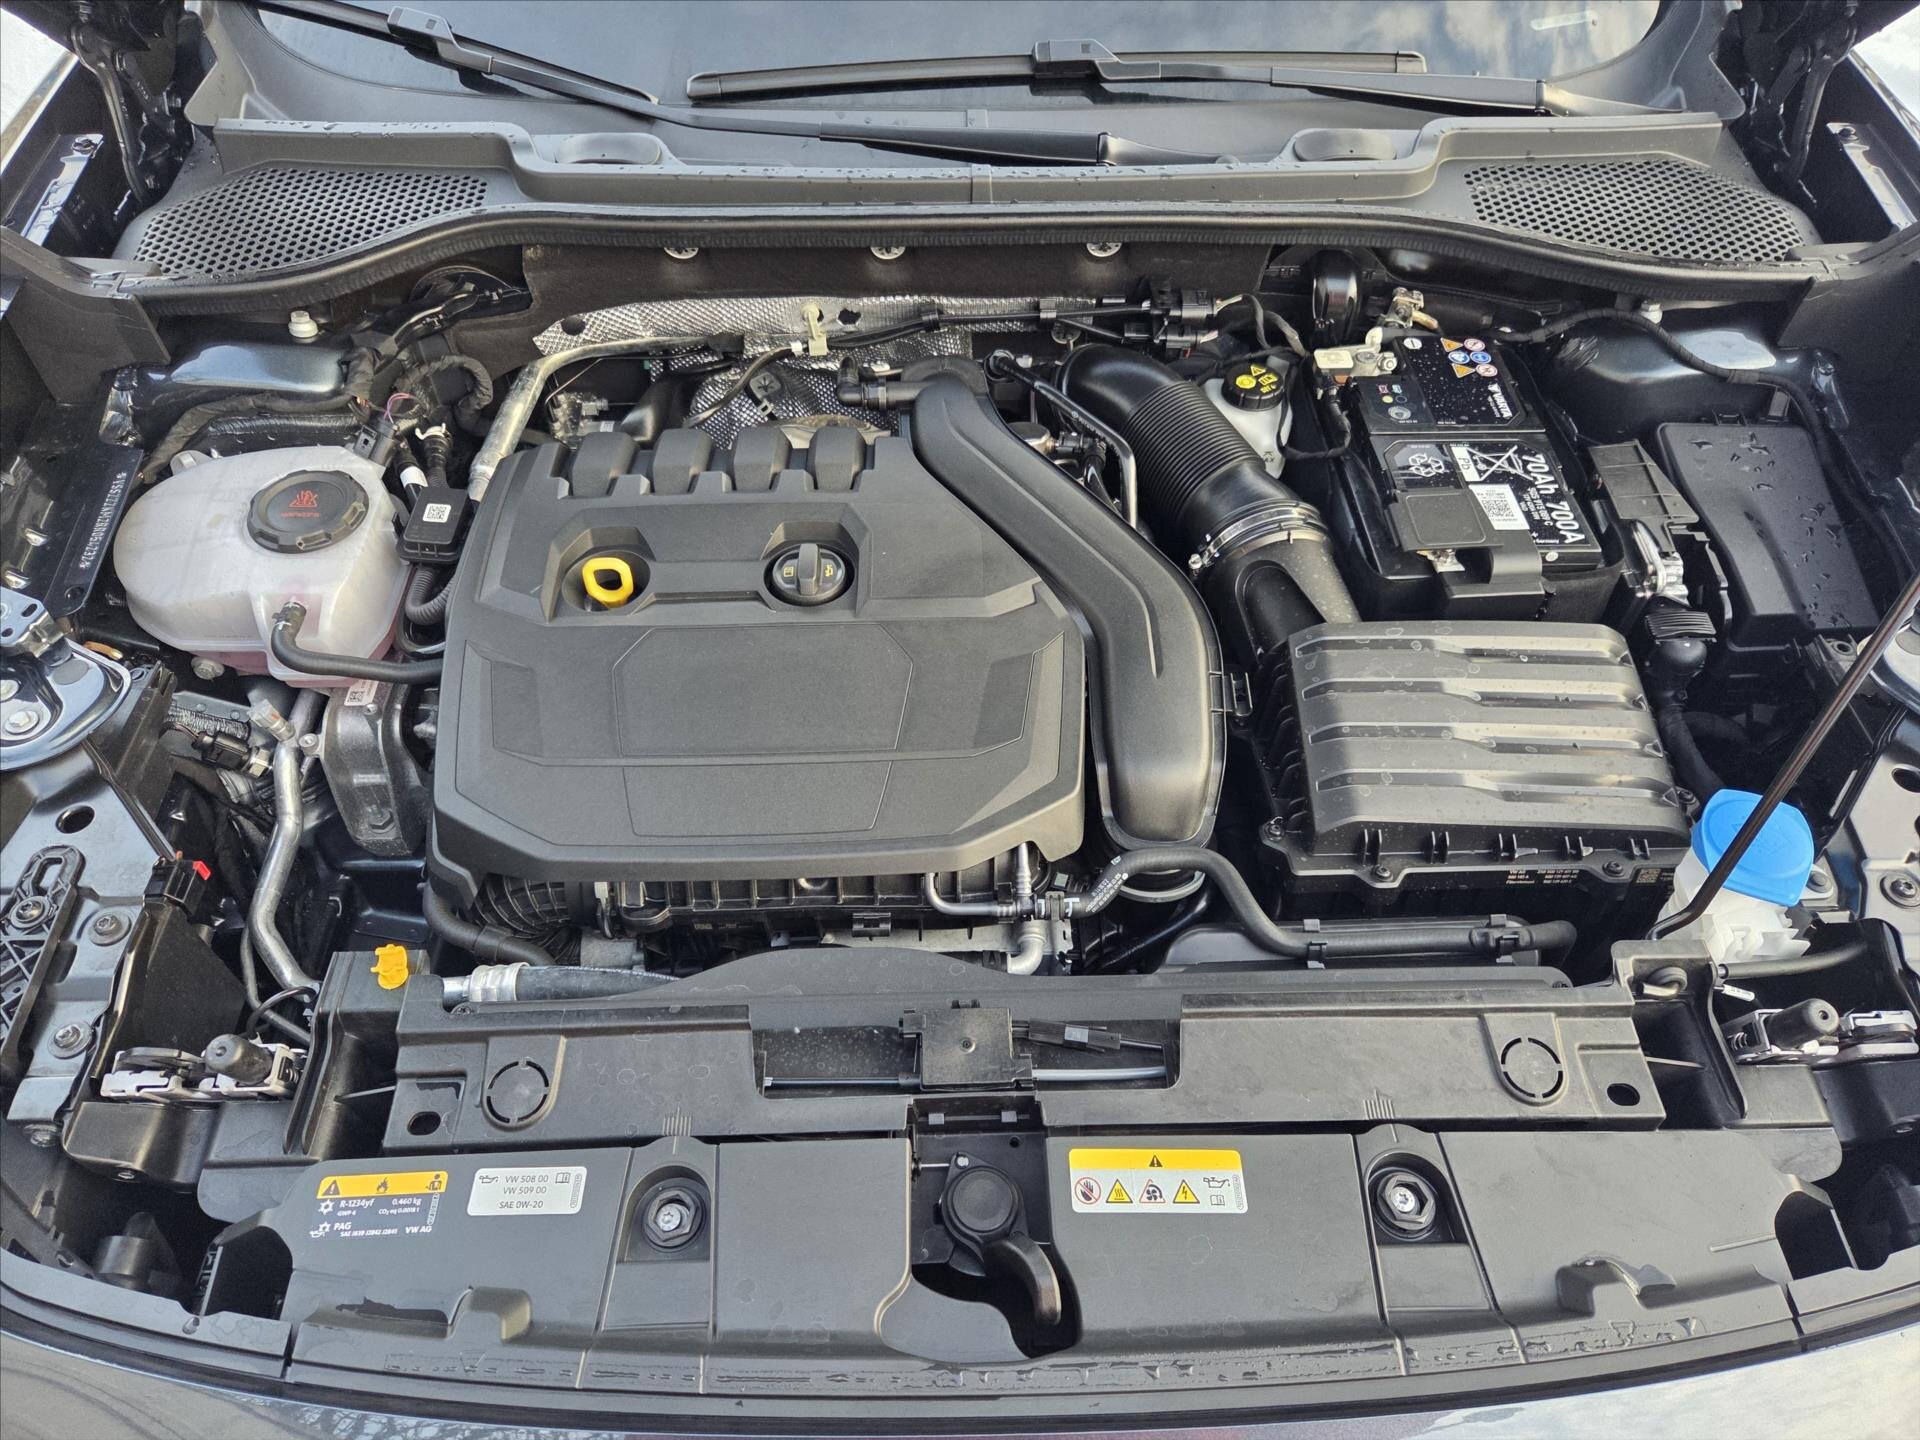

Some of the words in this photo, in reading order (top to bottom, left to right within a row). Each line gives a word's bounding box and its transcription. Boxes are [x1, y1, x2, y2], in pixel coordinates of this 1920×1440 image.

[1492, 391, 1513, 419] VARTA
[1459, 457, 1472, 471] Pb
[1522, 454, 1559, 494] 70Ah
[1546, 501, 1585, 543] 700A
[505, 1175, 519, 1183] VW
[520, 1175, 536, 1183] 508
[503, 1187, 517, 1195] VW
[535, 1186, 547, 1194] 00
[340, 1198, 376, 1208] R-1234yf
[412, 1197, 422, 1206] kg
[499, 1201, 514, 1209] SAE
[515, 1200, 544, 1209] 0W-20
[333, 1222, 352, 1231] PAG
[405, 1226, 419, 1234] VW
[419, 1225, 433, 1233] AG
